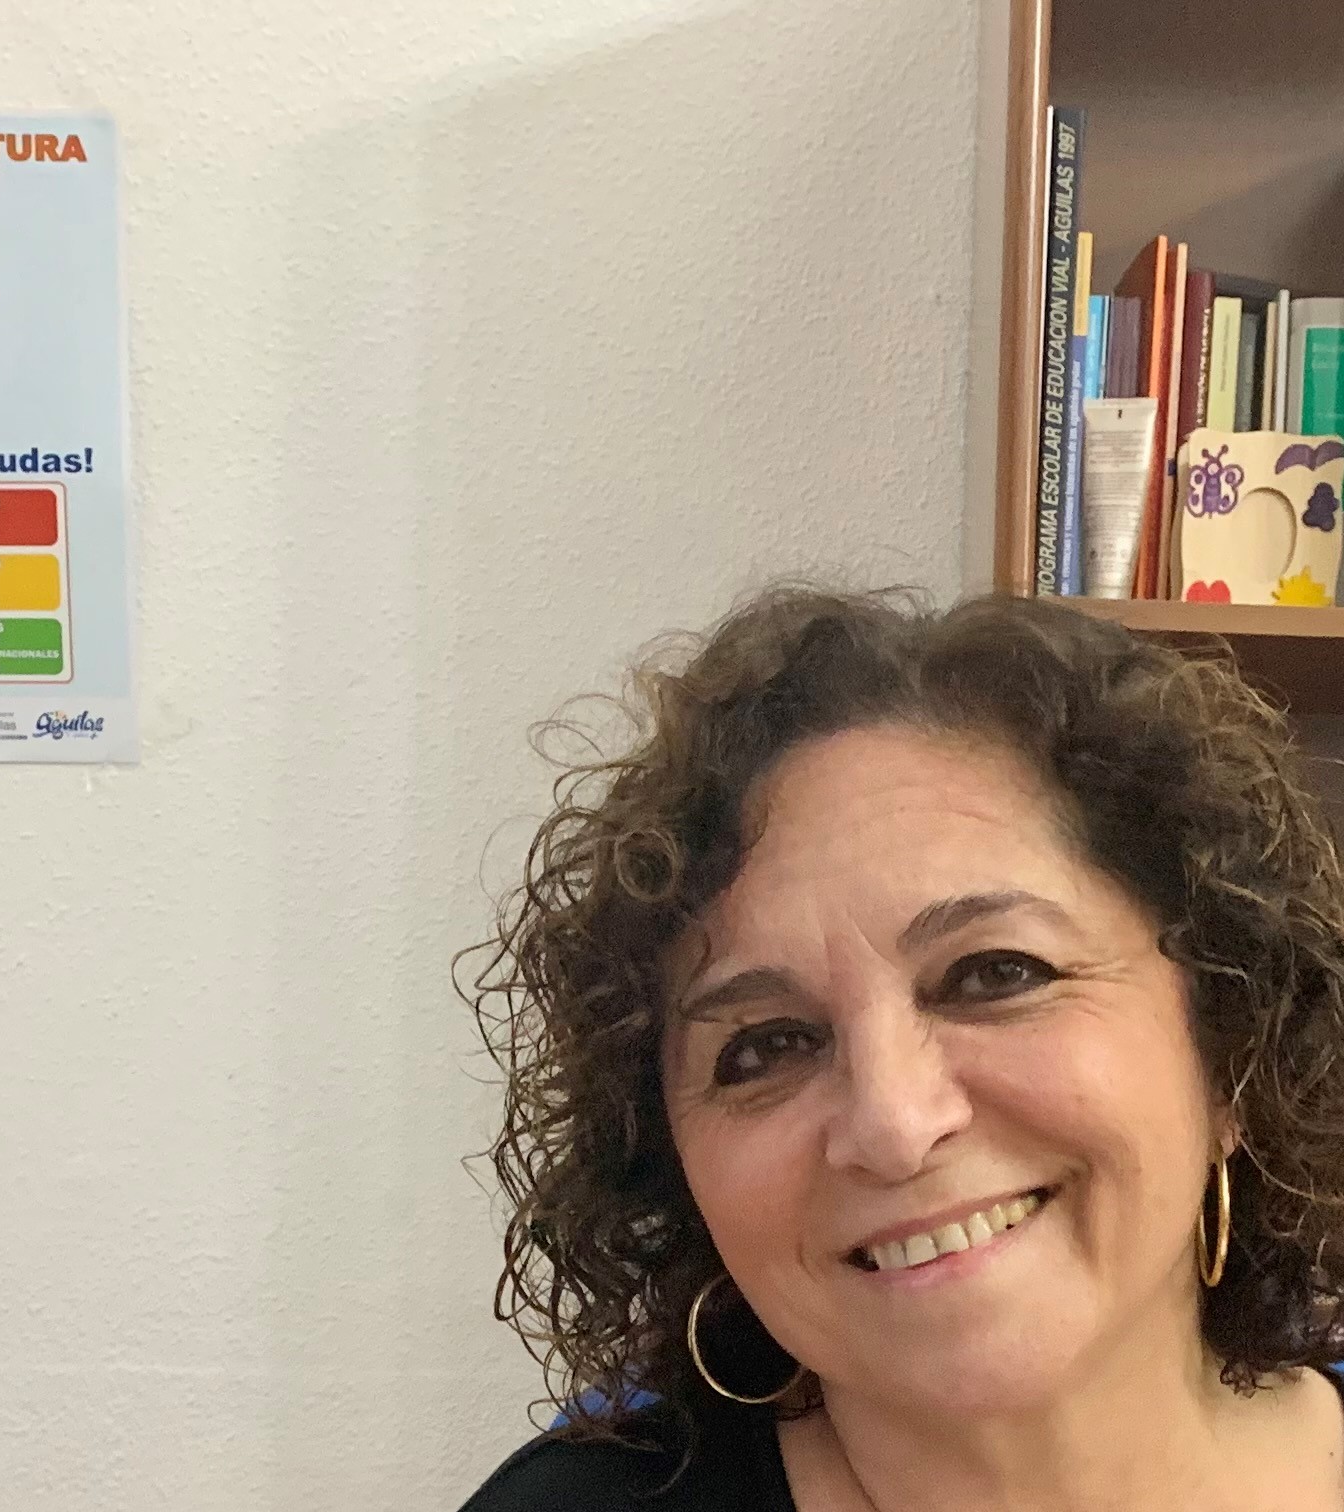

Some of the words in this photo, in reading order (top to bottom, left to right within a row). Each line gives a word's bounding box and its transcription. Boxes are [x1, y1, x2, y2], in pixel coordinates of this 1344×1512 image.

[1057, 122, 1076, 160] 1997
[1054, 164, 1075, 243] AGUILAS
[1051, 257, 1070, 292] VIAL
[1046, 297, 1068, 398] EDUCACION
[1045, 400, 1064, 425] DE
[1041, 425, 1062, 505] ESCOLAR
[0, 650, 60, 659] NACIONALES
